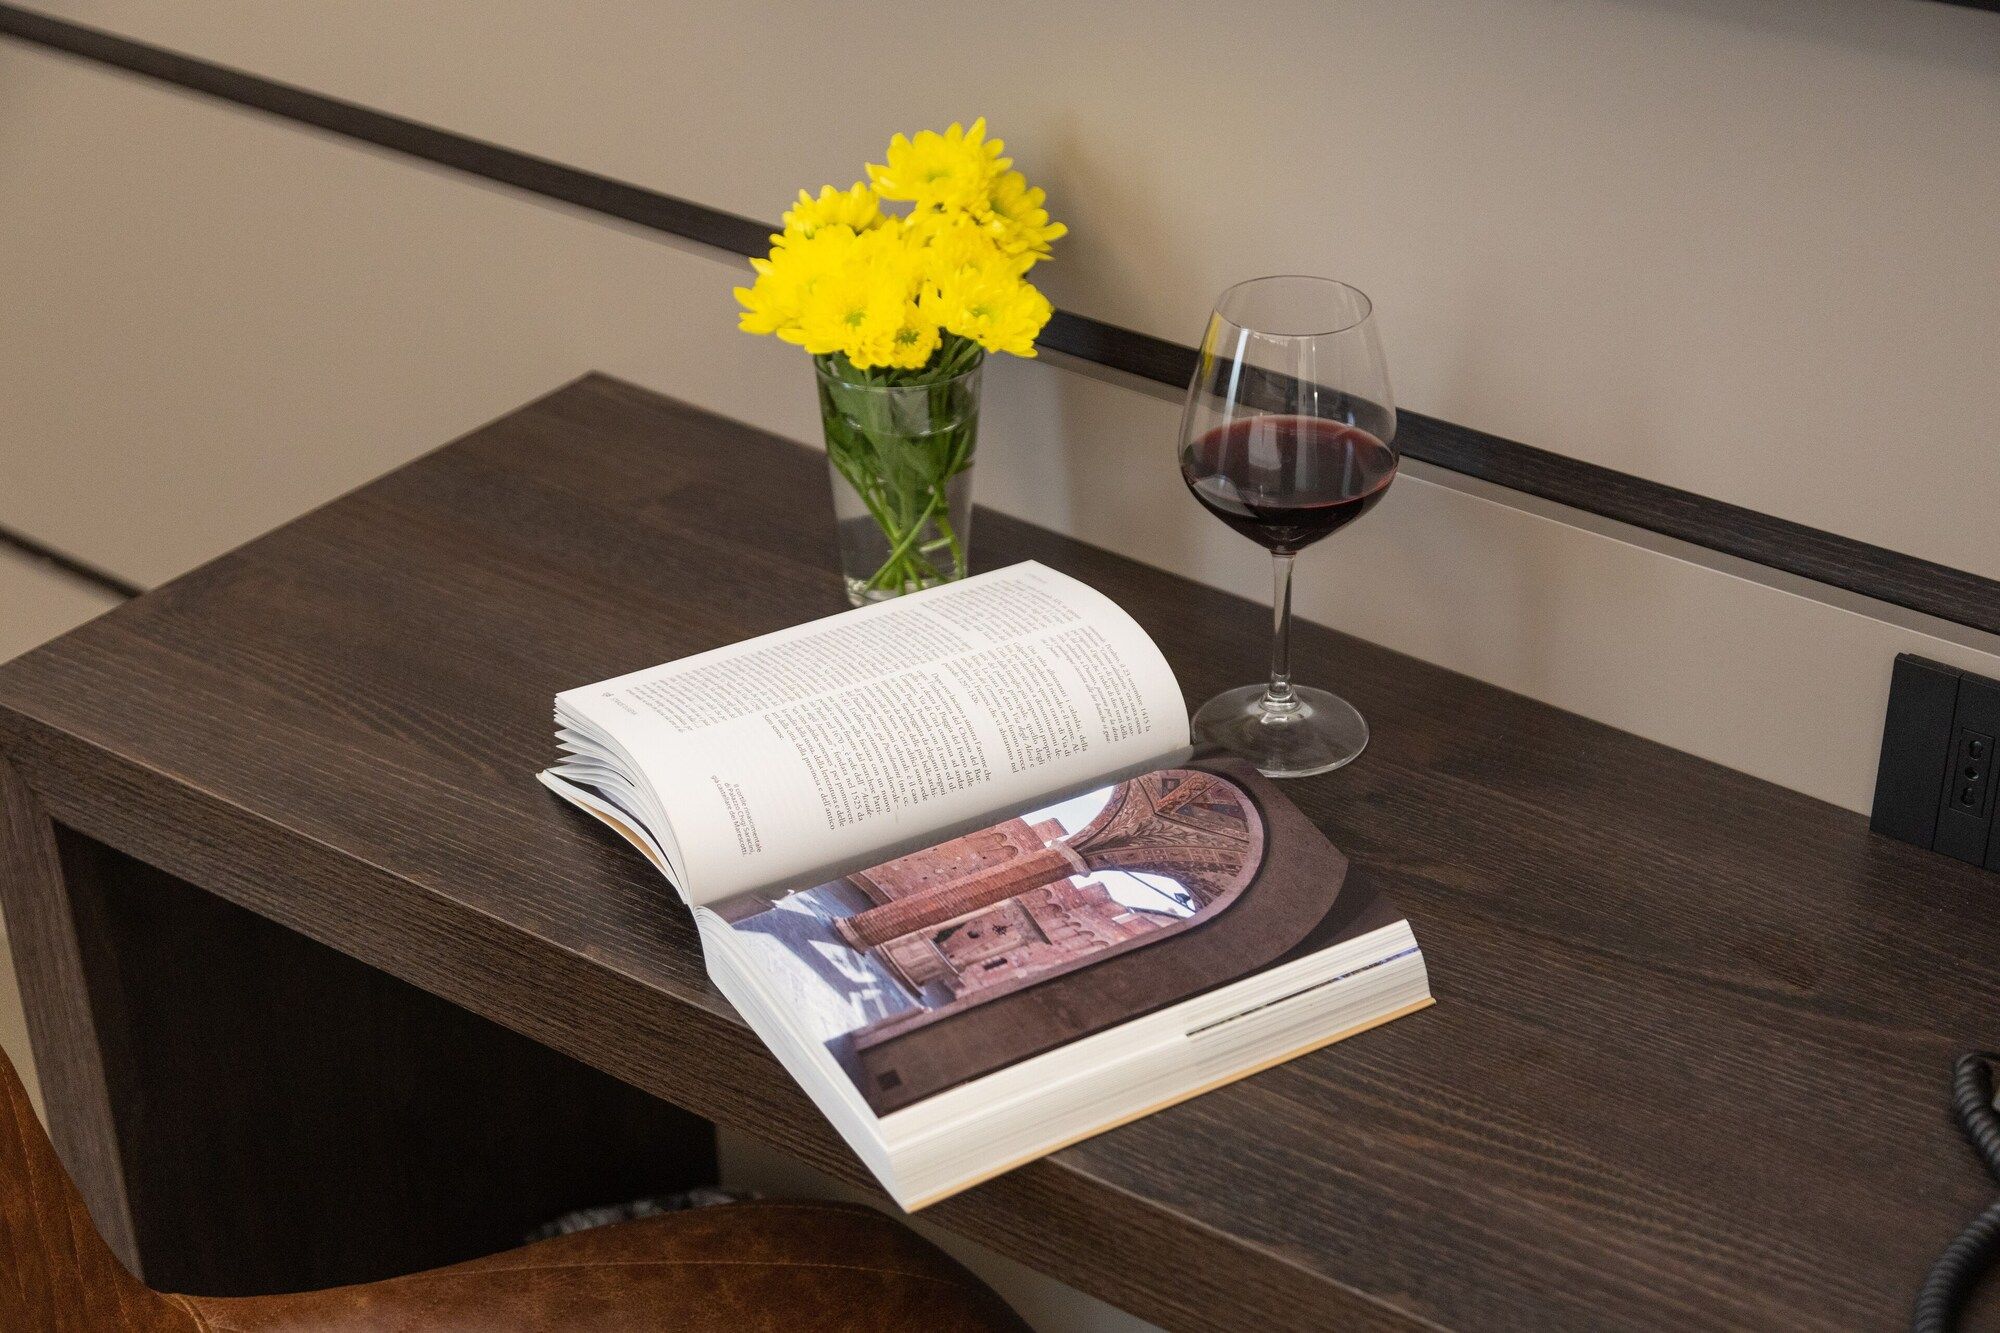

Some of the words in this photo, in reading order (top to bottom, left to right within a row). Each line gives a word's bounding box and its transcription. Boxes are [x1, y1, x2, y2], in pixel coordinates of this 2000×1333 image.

[1061, 735, 1070, 748] Via
[1079, 734, 1088, 752] della
[965, 769, 975, 787] delle
[851, 791, 863, 810] 1525
[881, 790, 892, 813] nuovo
